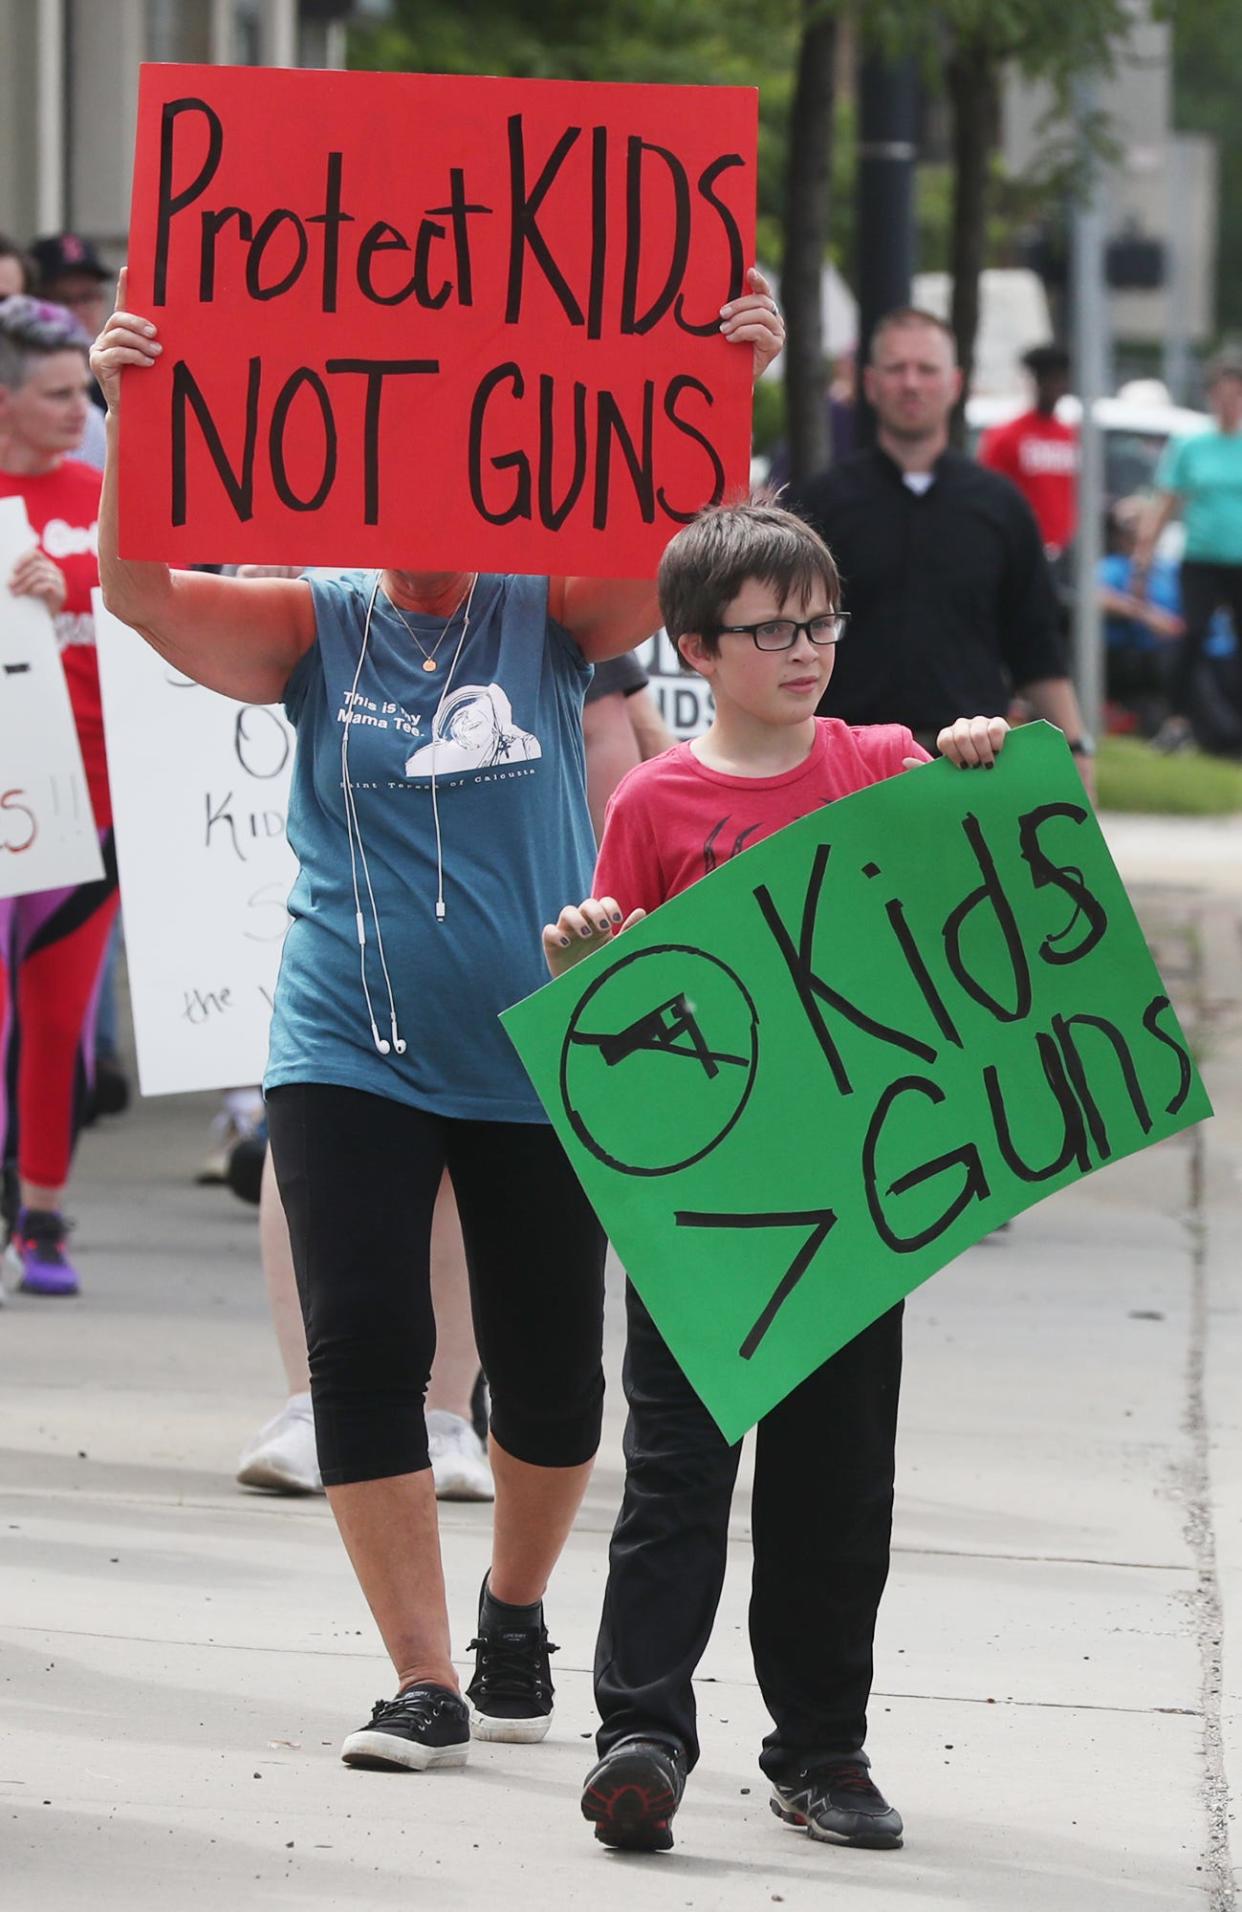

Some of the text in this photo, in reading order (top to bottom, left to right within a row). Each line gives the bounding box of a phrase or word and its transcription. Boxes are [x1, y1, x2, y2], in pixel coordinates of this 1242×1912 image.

[153, 97, 747, 340] Protect KIDS
[172, 356, 725, 532] NOT GUNS
[337, 708, 425, 737] Mama Tee.
[343, 691, 377, 711] This
[382, 702, 397, 714] is
[474, 769, 535, 783] Calcutta
[753, 802, 1108, 1095] Kids
[862, 994, 1191, 1254] Guns
